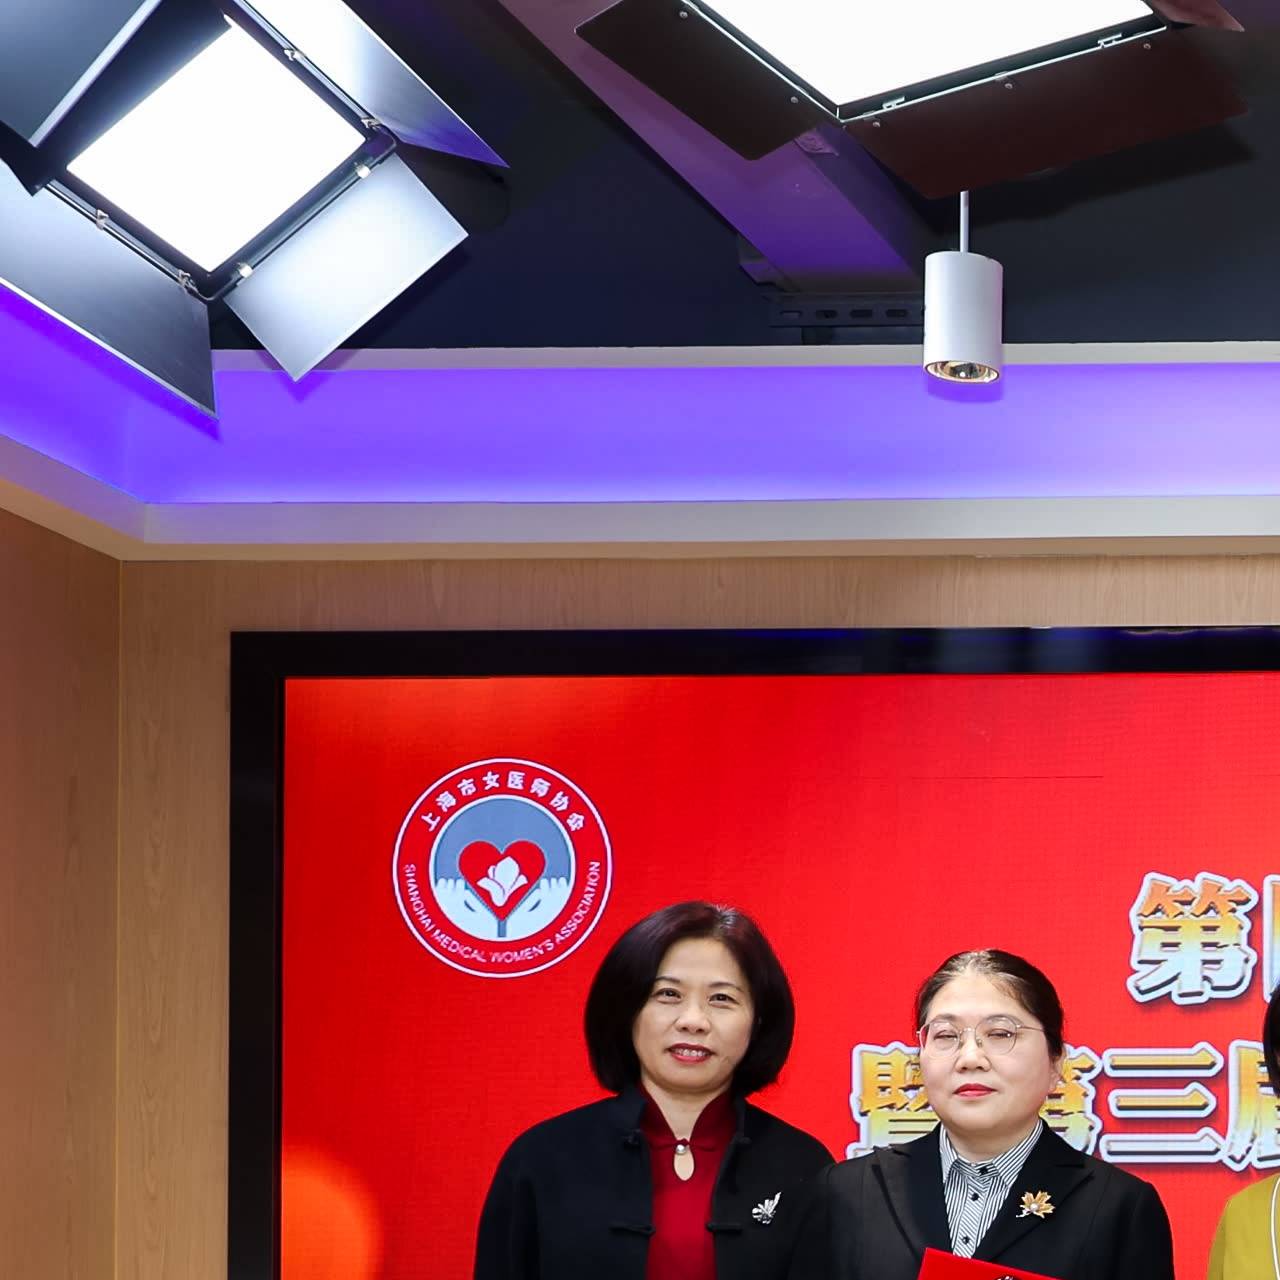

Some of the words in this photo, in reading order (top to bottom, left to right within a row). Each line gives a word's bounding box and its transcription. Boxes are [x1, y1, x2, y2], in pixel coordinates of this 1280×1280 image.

[421, 771, 586, 831] 上海市女医师协会
[404, 864, 435, 933] SHANGHAI
[431, 929, 487, 963] MEDICAL
[555, 861, 600, 944] ASSOCIATION
